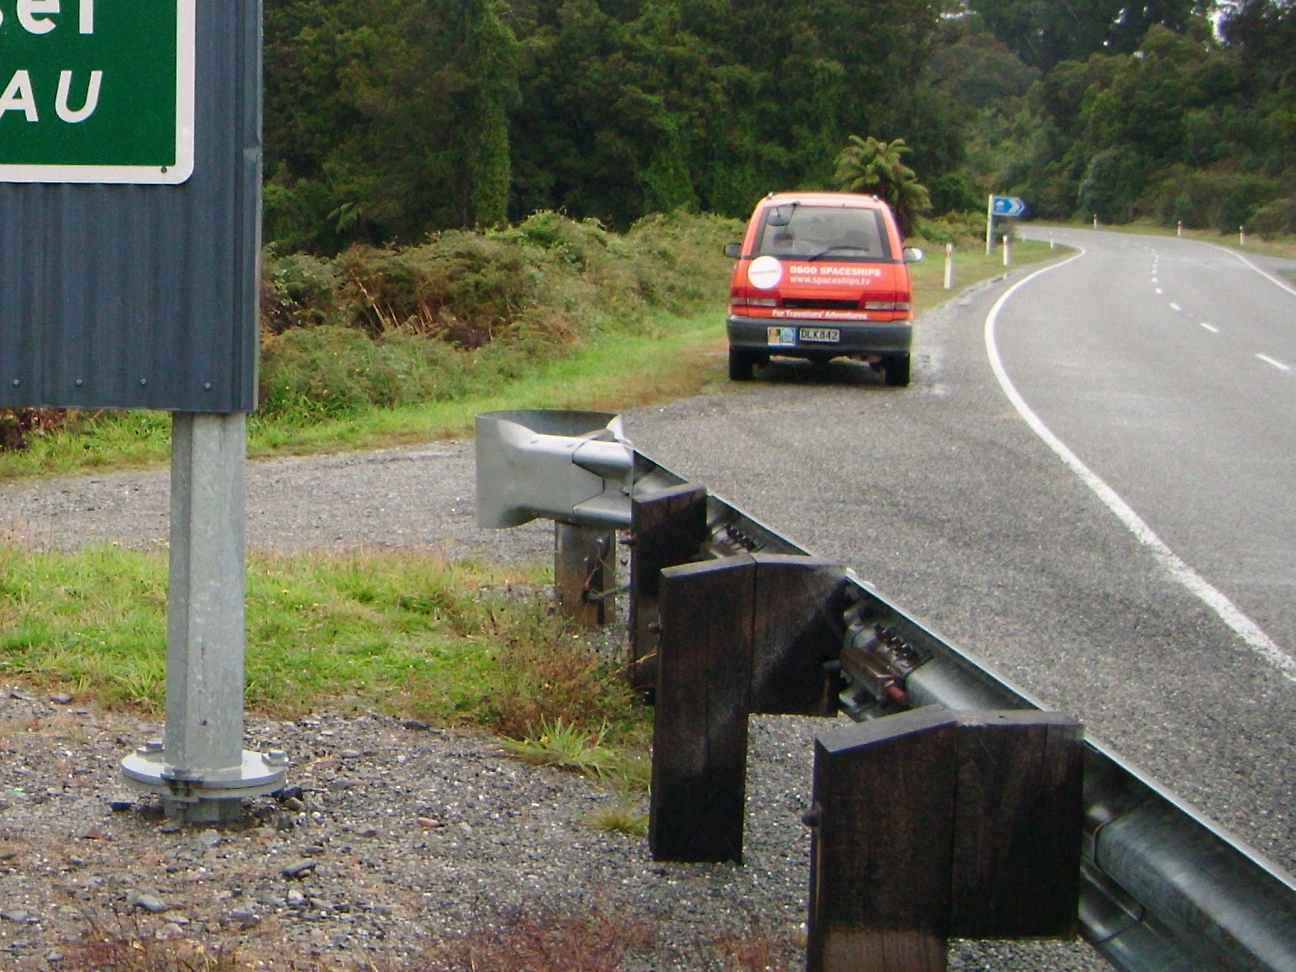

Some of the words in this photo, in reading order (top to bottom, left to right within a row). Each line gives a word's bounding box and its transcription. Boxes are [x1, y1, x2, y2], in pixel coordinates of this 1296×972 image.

[790, 266, 817, 275] 0800
[820, 267, 881, 277] SPACESHIPS
[790, 276, 871, 286] www.spaceships.tv
[772, 309, 785, 317] For
[825, 311, 868, 320] Adventures
[801, 329, 839, 340] DLK842
